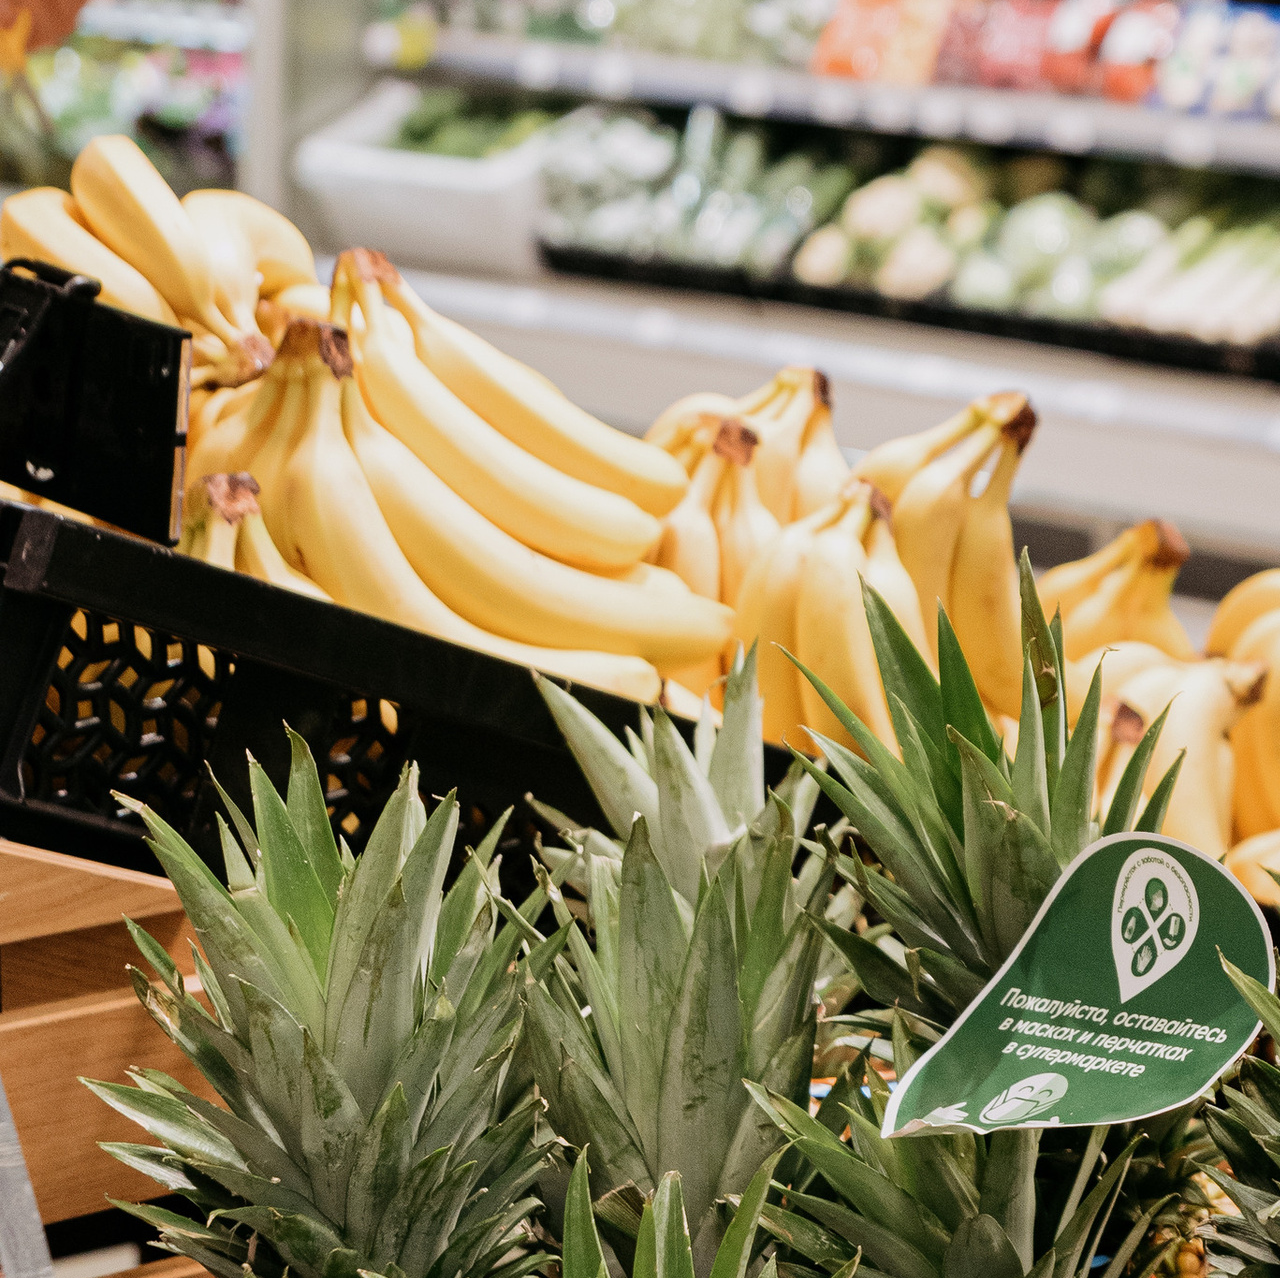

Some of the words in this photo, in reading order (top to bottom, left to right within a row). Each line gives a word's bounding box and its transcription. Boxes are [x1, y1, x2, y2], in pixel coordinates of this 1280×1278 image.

[1000, 987, 1109, 1026] Пожалуйста,
[1113, 1011, 1228, 1044] оставайтесь
[998, 1017, 1014, 1031] в
[1012, 1019, 1080, 1042] масках
[1076, 1030, 1093, 1044] и
[1091, 1033, 1193, 1062] перчатках
[1002, 1041, 1018, 1054] в
[1016, 1044, 1146, 1078] супермаркете
